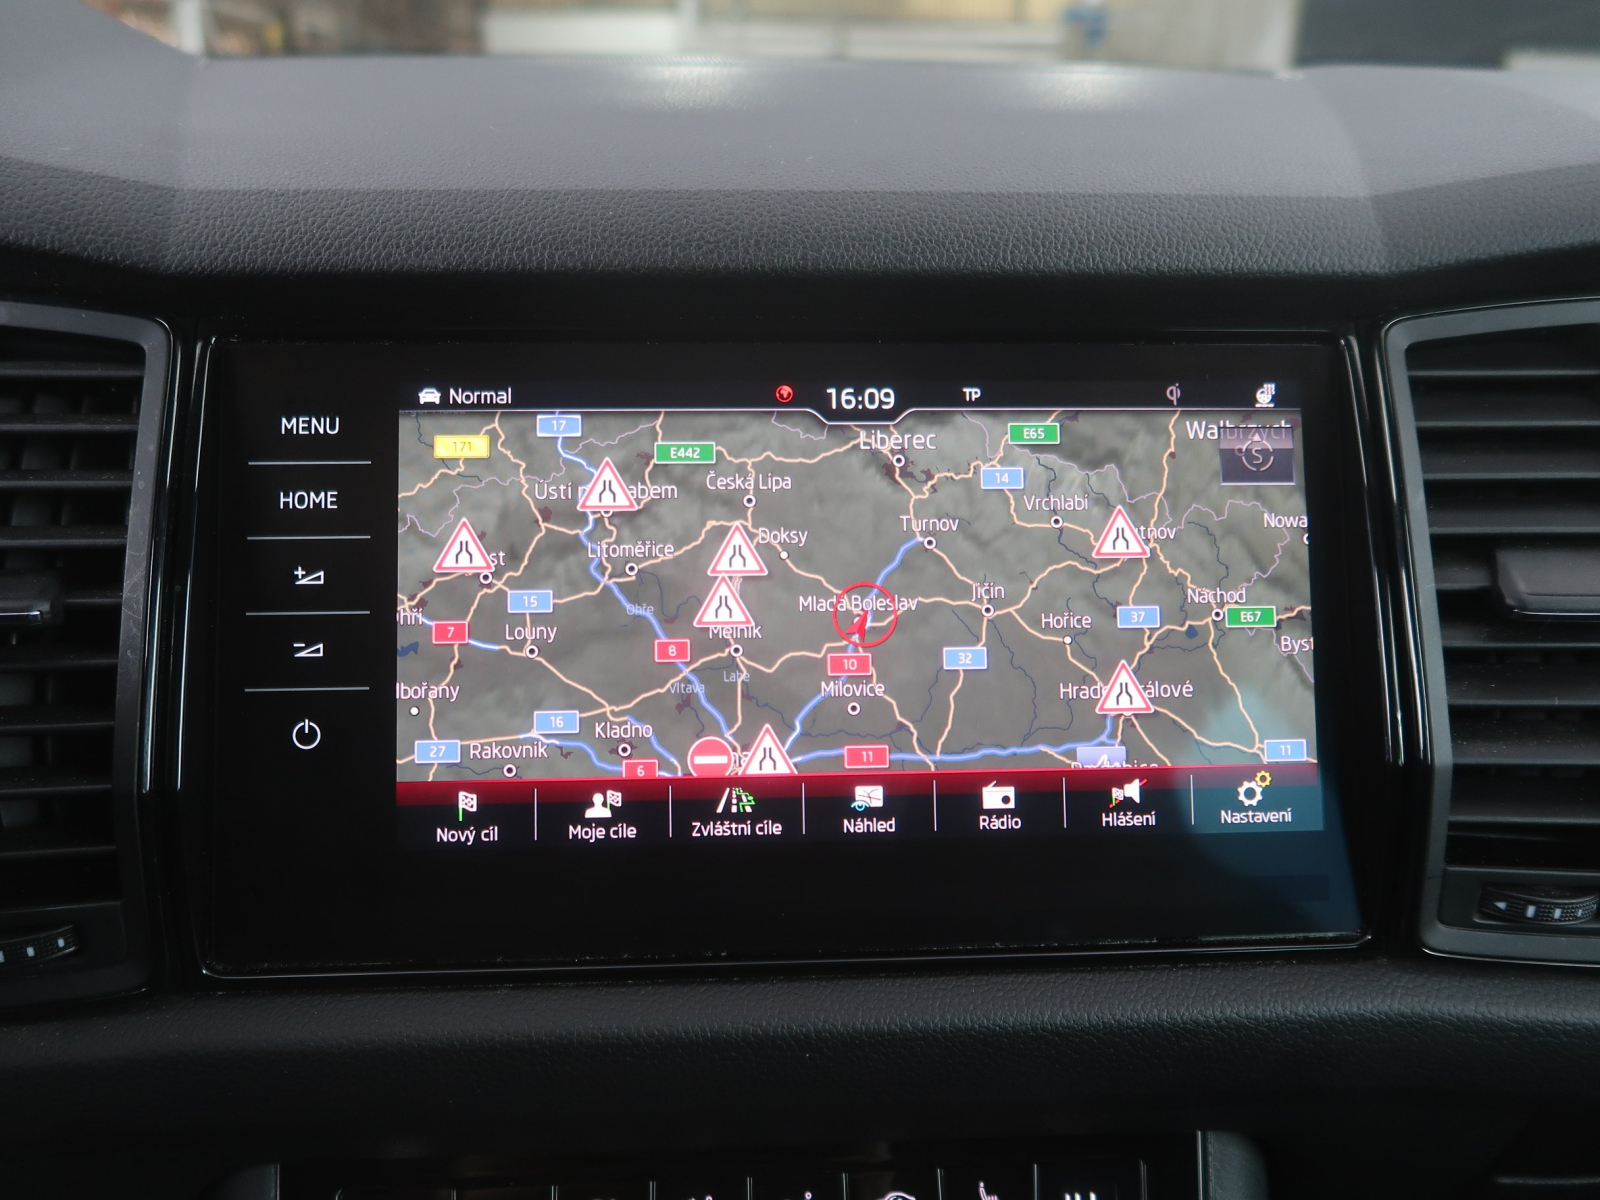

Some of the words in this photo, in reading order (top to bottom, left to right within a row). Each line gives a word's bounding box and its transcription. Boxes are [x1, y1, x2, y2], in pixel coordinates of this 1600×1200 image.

[450, 388, 512, 404] Normal
[826, 388, 896, 410] 16:09
[963, 388, 982, 401] TP
[281, 417, 340, 435] MENU
[552, 421, 567, 431] 17
[1023, 428, 1045, 439] E65
[453, 442, 472, 451] 171
[860, 431, 937, 450] Liberec
[670, 448, 700, 459] E442
[706, 470, 754, 490] Česká
[759, 473, 792, 492] Lípa
[996, 473, 1009, 483] 14
[534, 479, 572, 500] Ústí
[628, 482, 678, 499] abem
[280, 491, 338, 509] HOME
[1024, 494, 1089, 511] Vrchlabí
[900, 516, 959, 532] Turnov
[758, 527, 809, 547] Doksy
[587, 540, 675, 558] Litoměřice
[972, 582, 1006, 602] Jičín
[1187, 587, 1247, 604] Náchod
[523, 596, 538, 607] 15
[627, 603, 654, 616] Ohře
[851, 594, 919, 612] Boleslav
[1041, 612, 1092, 630] Hořice
[1131, 611, 1146, 622] 37
[1240, 611, 1261, 623] E67
[447, 626, 455, 638] 7
[505, 624, 558, 643] Louny
[668, 645, 677, 657] 8
[958, 653, 973, 664] 32
[842, 658, 858, 670] 10
[669, 682, 705, 695] Vltava
[821, 681, 885, 698] Milovice
[549, 716, 564, 728] 16
[595, 722, 653, 739] Kladno
[429, 746, 446, 758] 27
[469, 742, 548, 759] Rakovník
[861, 751, 874, 763] 11
[1280, 745, 1292, 756] 11
[637, 765, 645, 776] 6
[979, 814, 1022, 830] Rádio
[1101, 811, 1156, 827] Hlášení
[1220, 808, 1292, 824] Nastavení
[568, 825, 606, 842] Moje
[610, 824, 637, 839] cíle
[691, 821, 751, 837] Zvláštní
[756, 820, 783, 836] cíle
[843, 817, 896, 834] Náhled
[436, 827, 476, 847] Nový
[480, 826, 498, 842] cíl
